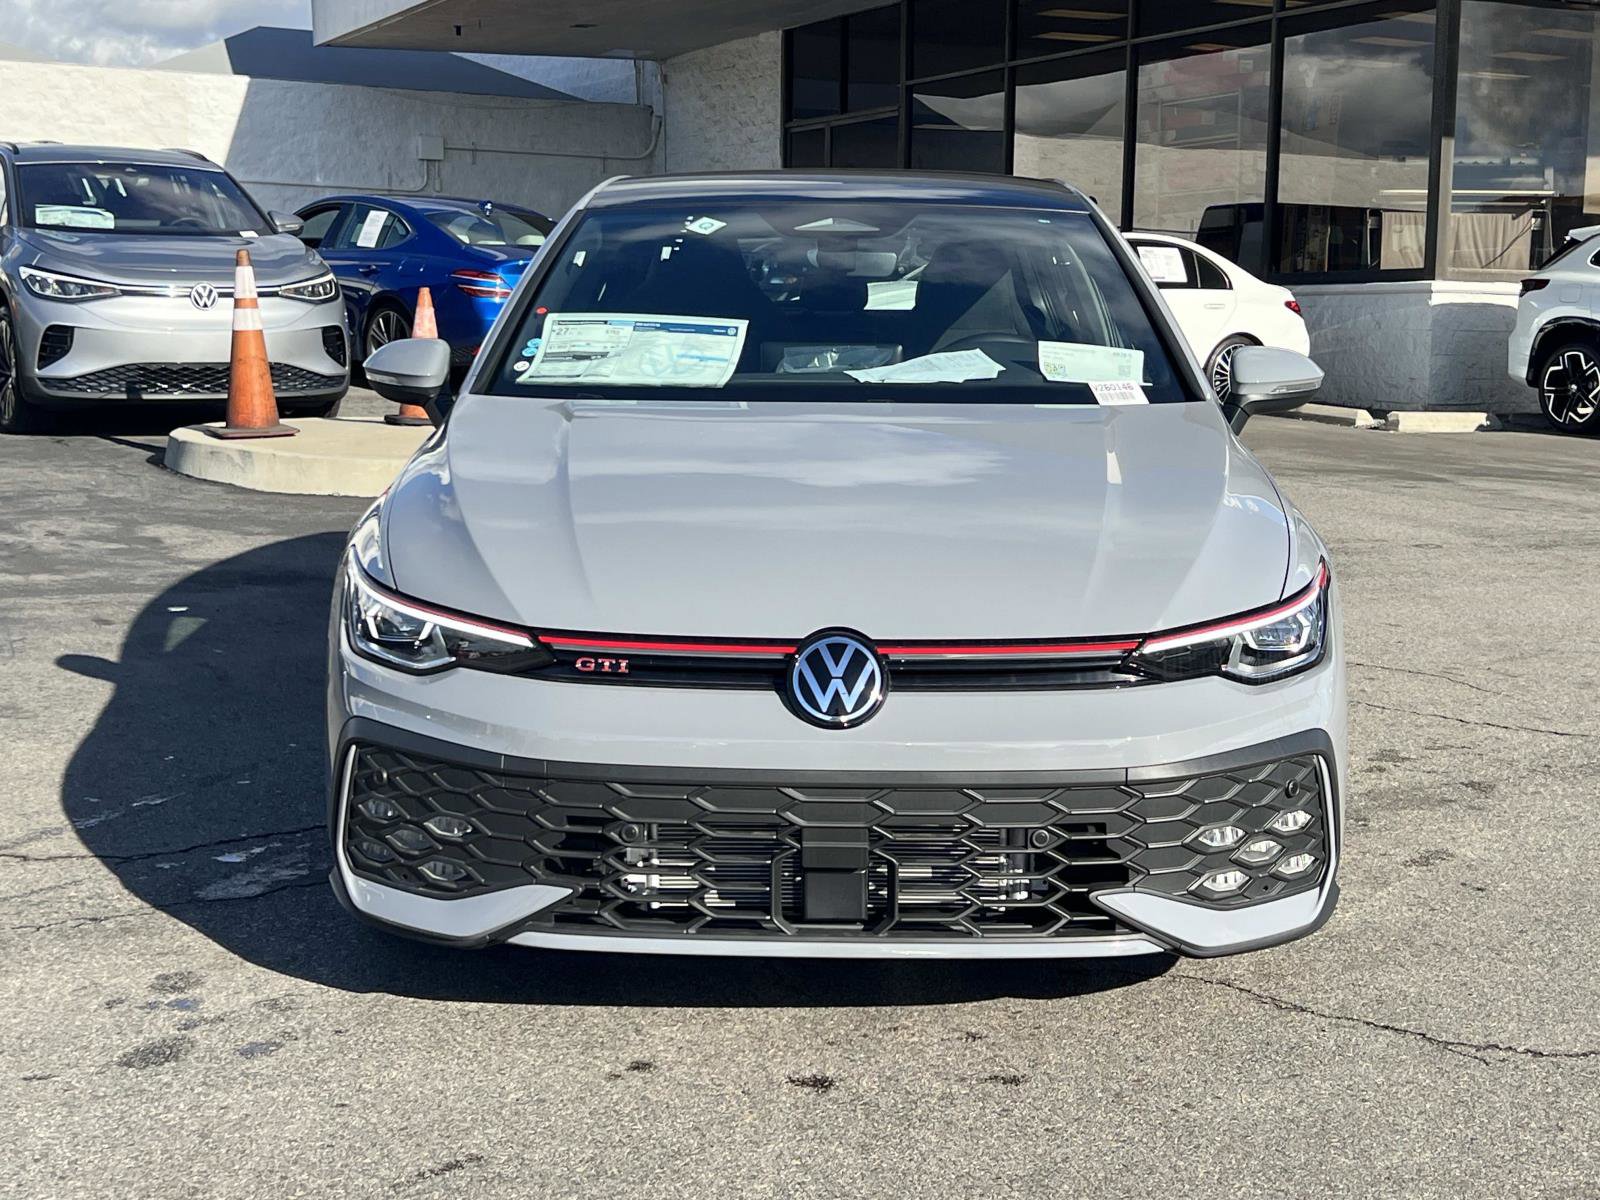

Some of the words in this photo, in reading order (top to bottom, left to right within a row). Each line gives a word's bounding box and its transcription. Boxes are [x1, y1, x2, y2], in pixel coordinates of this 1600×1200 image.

[555, 327, 570, 336] 27
[575, 656, 629, 673] GTI
[796, 640, 877, 717] VW
